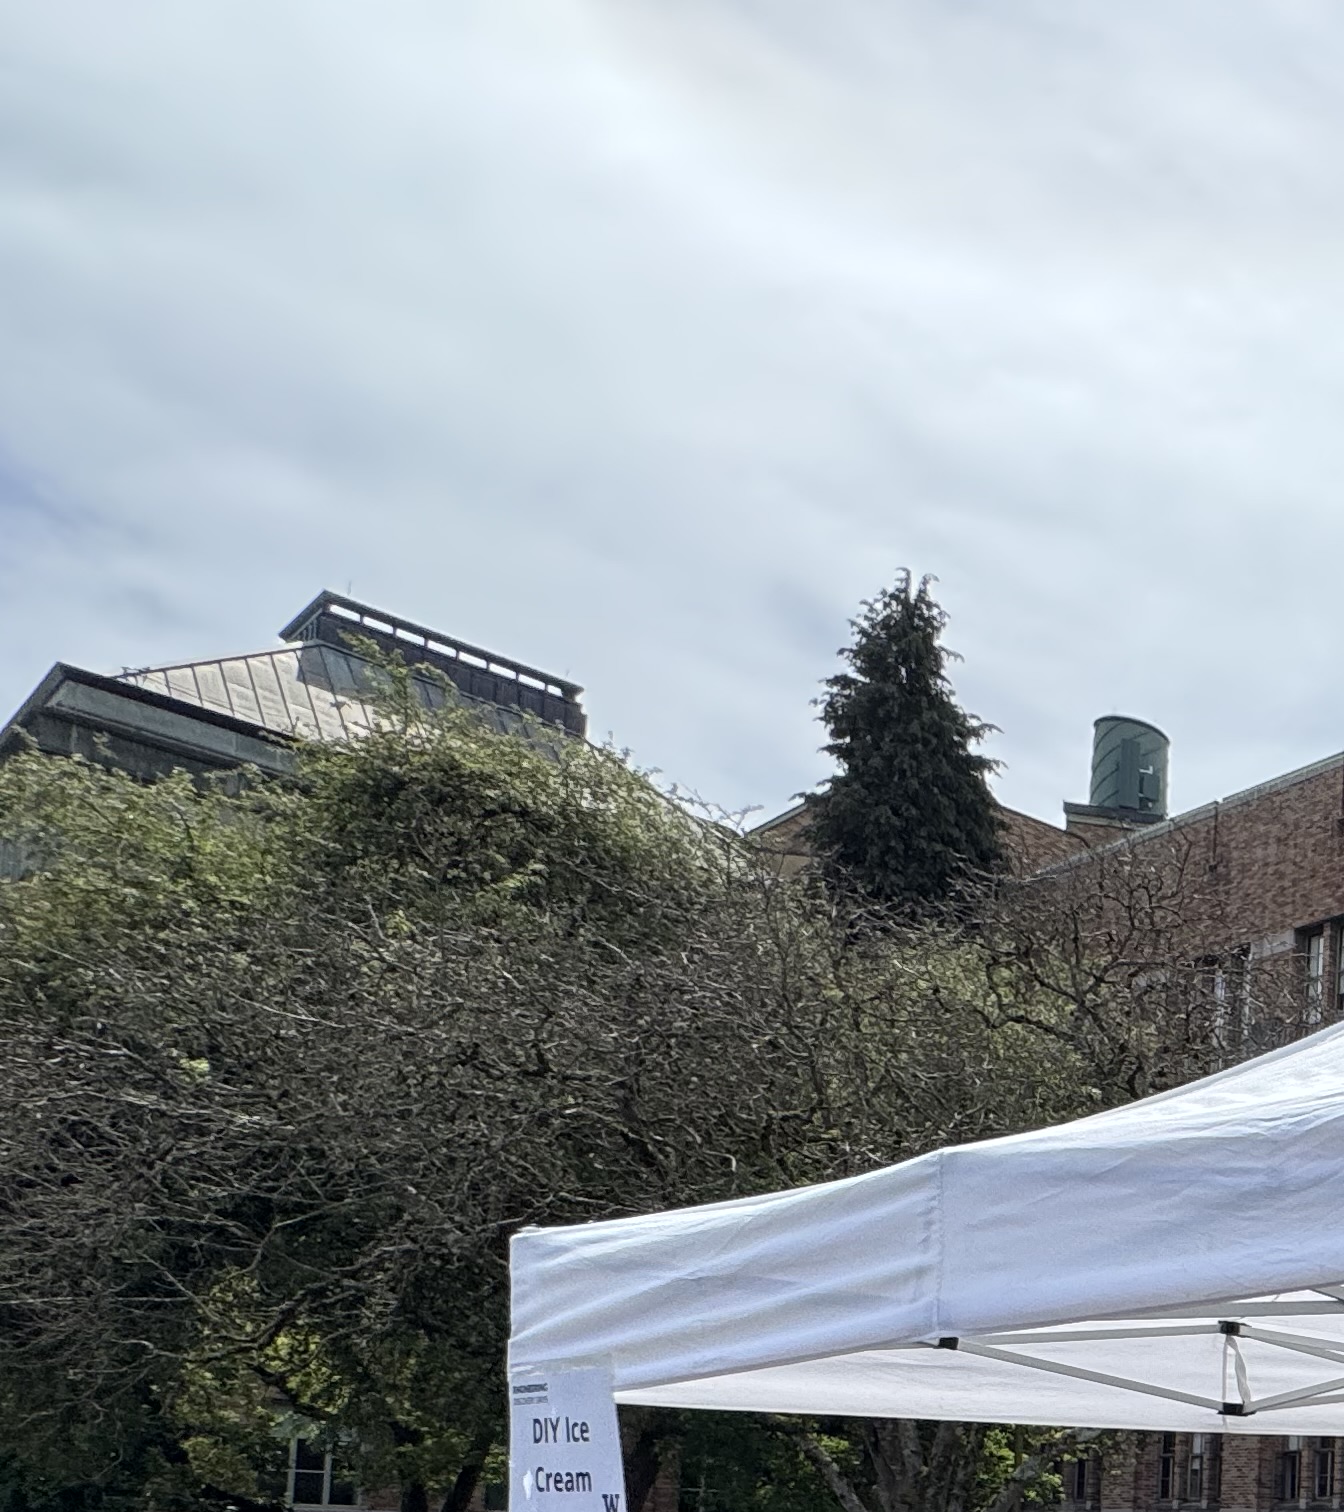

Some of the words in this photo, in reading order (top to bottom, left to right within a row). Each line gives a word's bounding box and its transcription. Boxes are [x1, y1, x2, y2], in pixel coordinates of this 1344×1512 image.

[532, 1416, 560, 1444] DIY
[565, 1416, 590, 1443] Ice
[535, 1466, 593, 1493] Cream
